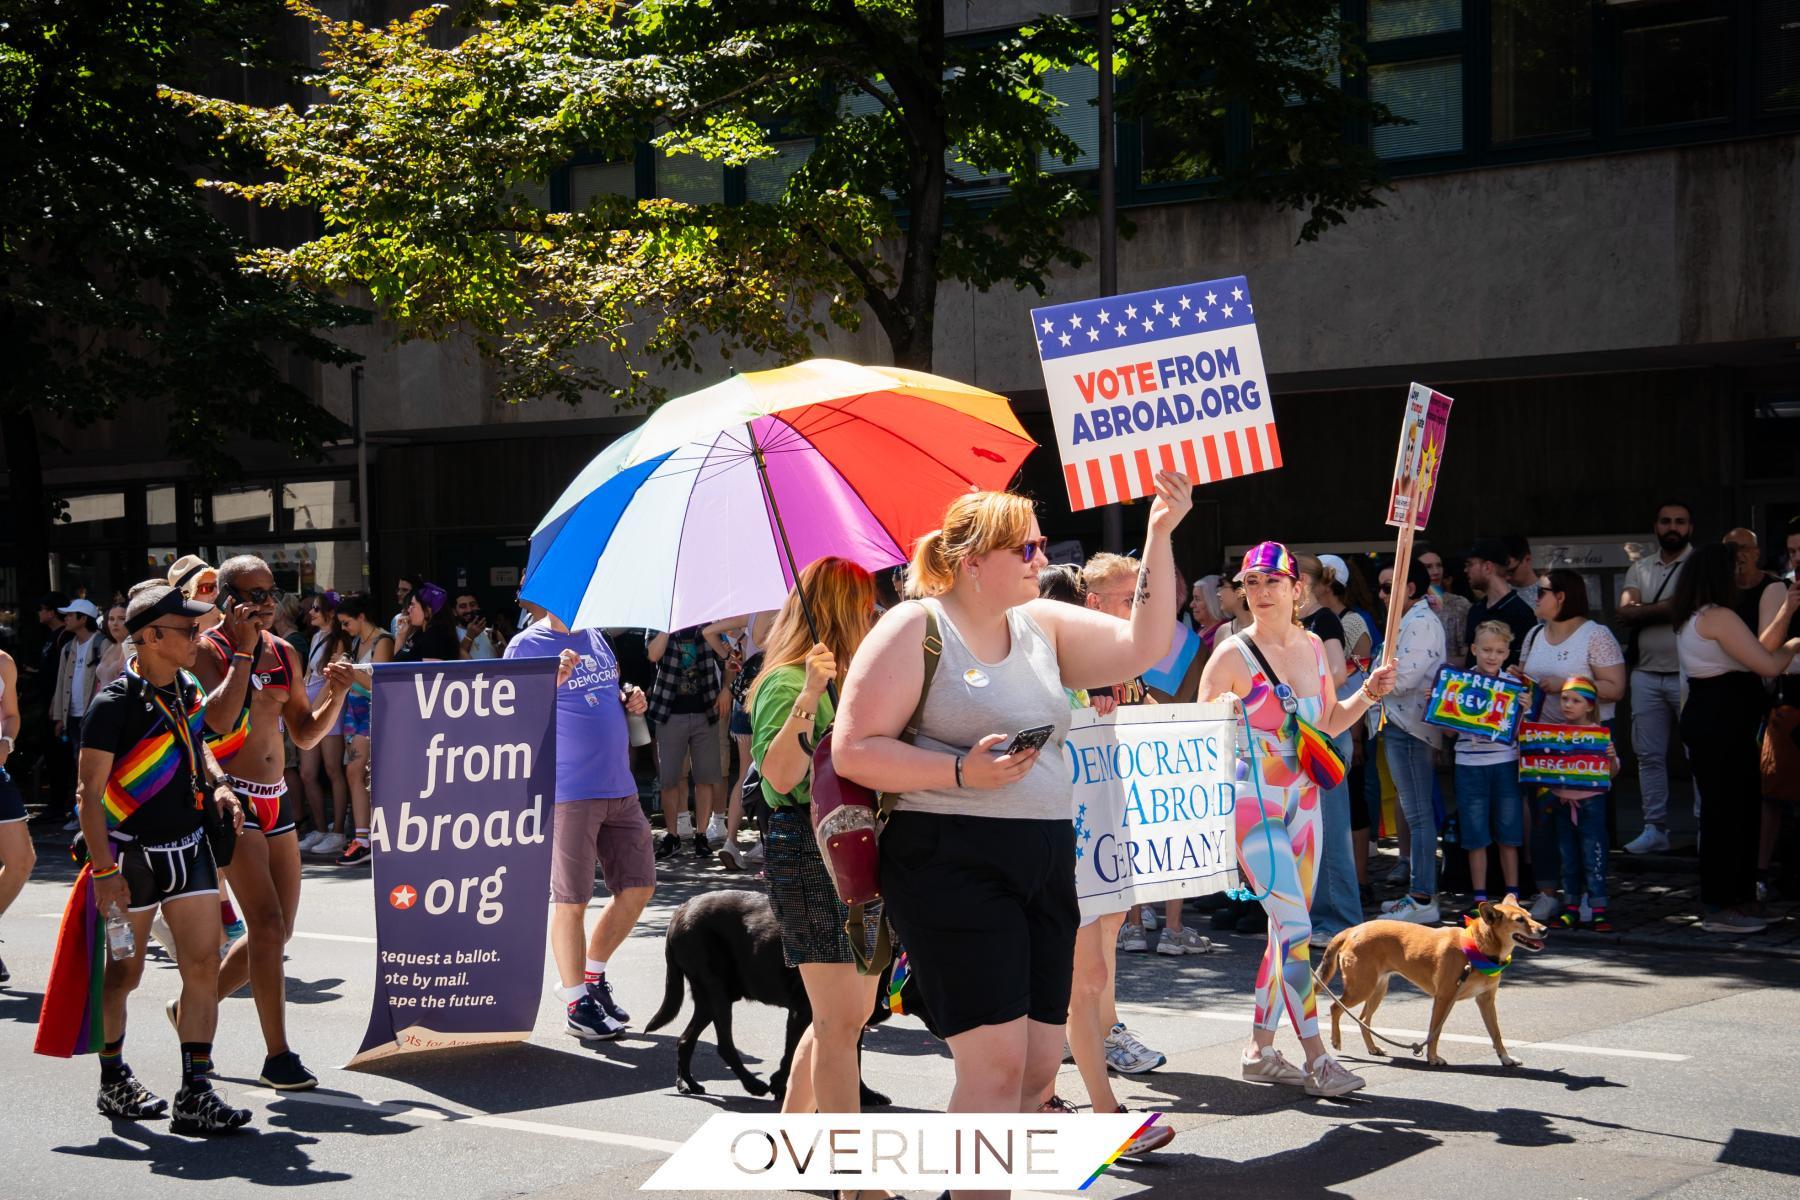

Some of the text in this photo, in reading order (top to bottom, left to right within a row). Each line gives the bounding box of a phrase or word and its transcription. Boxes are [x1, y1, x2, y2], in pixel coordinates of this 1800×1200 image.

[1072, 380, 1261, 446] ABROAD.ORG
[1440, 669, 1506, 693] EXTREM
[414, 672, 516, 719] Vote
[1432, 688, 1515, 715] LIEBEVOLL
[1525, 730, 1596, 744] EXTREM
[420, 733, 532, 799] from
[1521, 756, 1610, 774] LIEBEVOLL
[1121, 779, 1236, 828] ABROD
[1093, 829, 1227, 883] GERMANY
[443, 953, 452, 965] a
[455, 949, 501, 964] ballot.
[412, 972, 431, 989] by
[434, 972, 470, 987] mail.
[421, 995, 445, 1008] the
[449, 994, 497, 1007] future.
